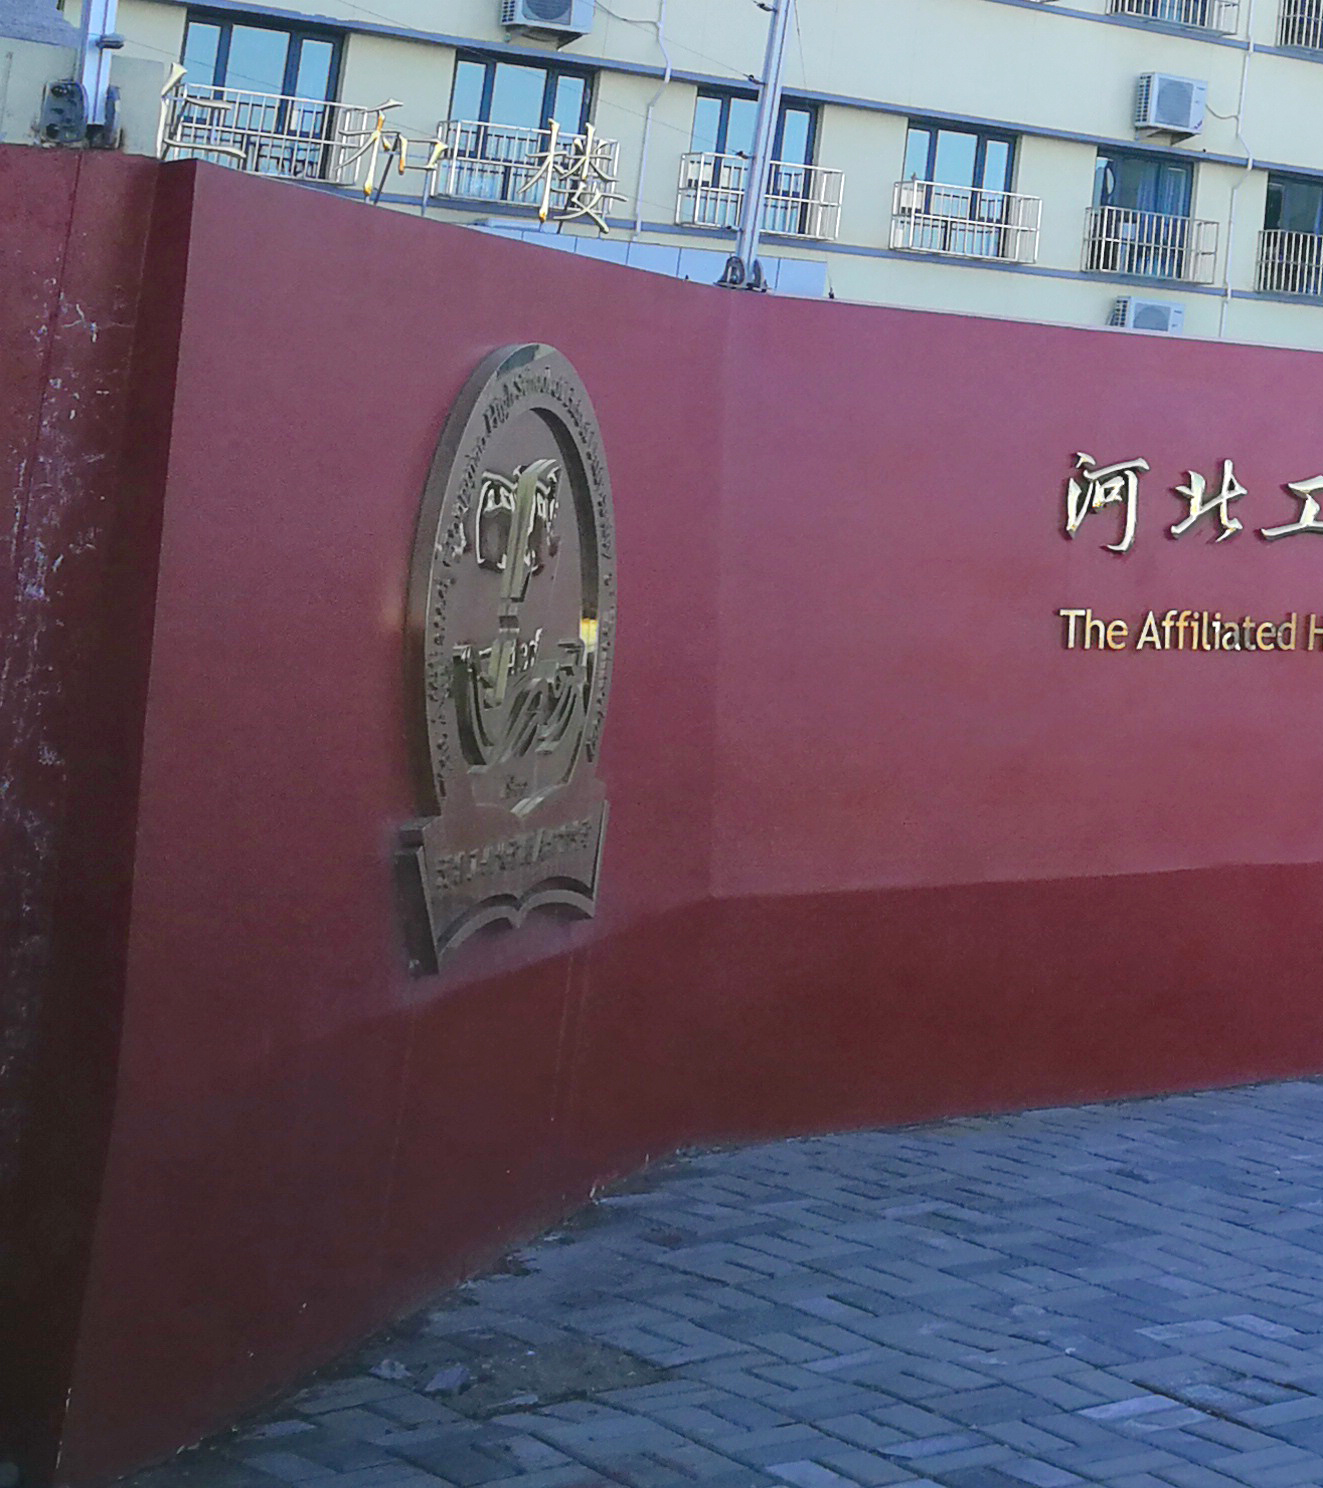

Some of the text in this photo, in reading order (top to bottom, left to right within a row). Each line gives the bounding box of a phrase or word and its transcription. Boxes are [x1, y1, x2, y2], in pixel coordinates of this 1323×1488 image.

[156, 61, 628, 234] 仁和楼
[1060, 609, 1128, 650] The
[1137, 611, 1297, 652] Affiliated
